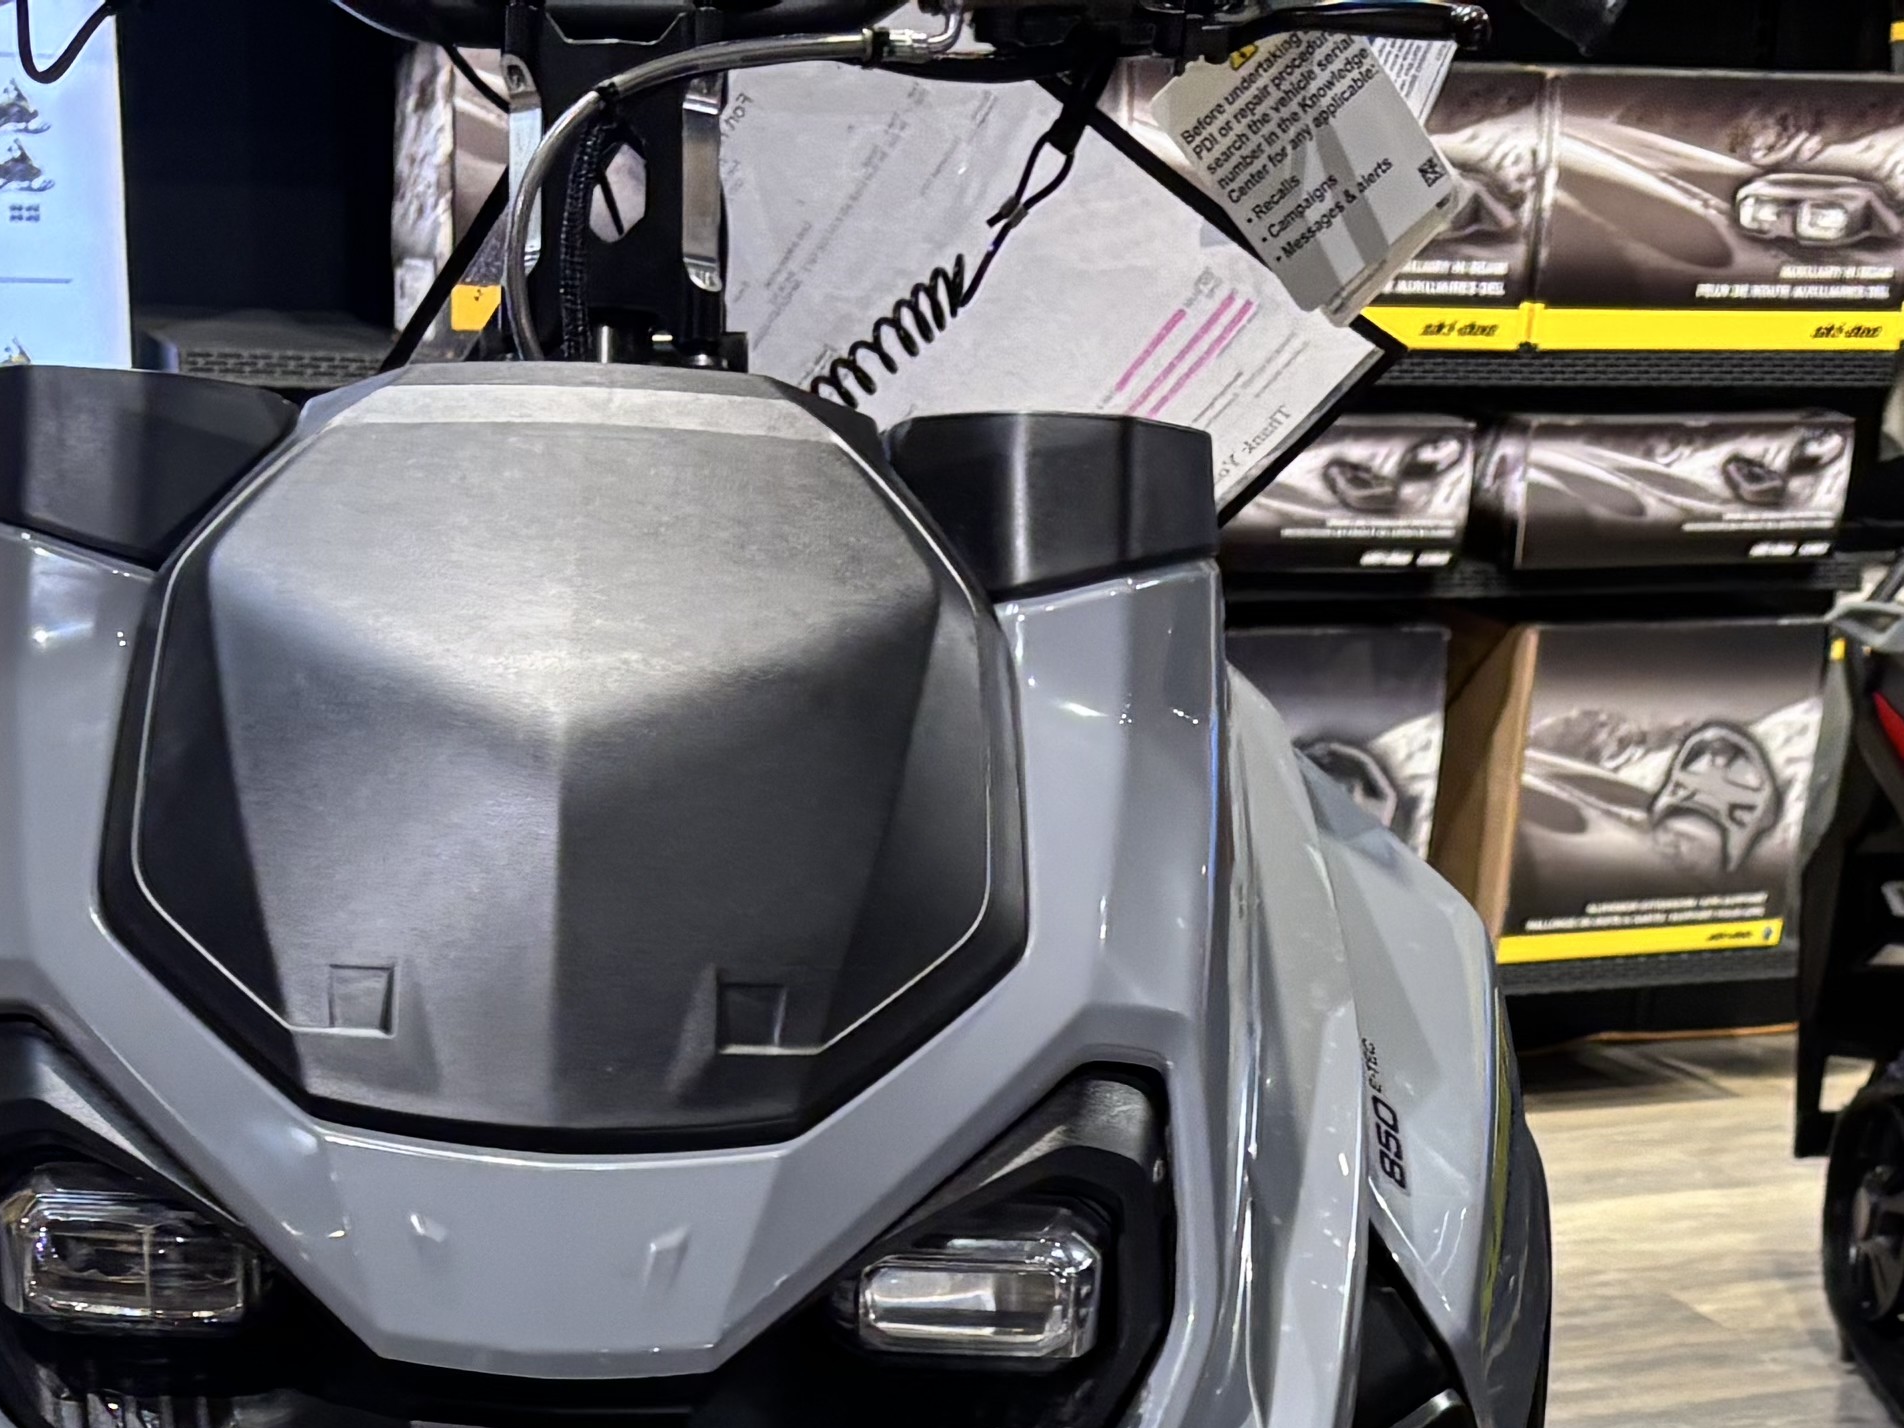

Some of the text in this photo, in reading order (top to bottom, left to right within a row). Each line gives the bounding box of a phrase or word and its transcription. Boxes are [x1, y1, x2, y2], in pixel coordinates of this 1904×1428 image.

[1180, 31, 1303, 146] Before undertaking
[1192, 133, 1218, 160] PDI
[1218, 121, 1234, 138] or
[1232, 80, 1270, 127] repair
[1206, 135, 1250, 174] search
[1248, 113, 1271, 137] the
[1271, 69, 1316, 115] vehicle
[1317, 35, 1355, 73] serial
[1217, 149, 1263, 190] number
[1263, 134, 1279, 151] in
[1277, 112, 1302, 137] the
[1300, 48, 1370, 113] Knowledge
[1227, 165, 1271, 204] Center
[1270, 148, 1289, 169] for
[1289, 127, 1315, 155] any
[1313, 63, 1380, 129] applicable:
[1252, 174, 1300, 219] Recalls
[1267, 173, 1338, 239] Campaigns
[1281, 156, 1394, 260] Messages & alerts
[1371, 1094, 1407, 1190] 850
